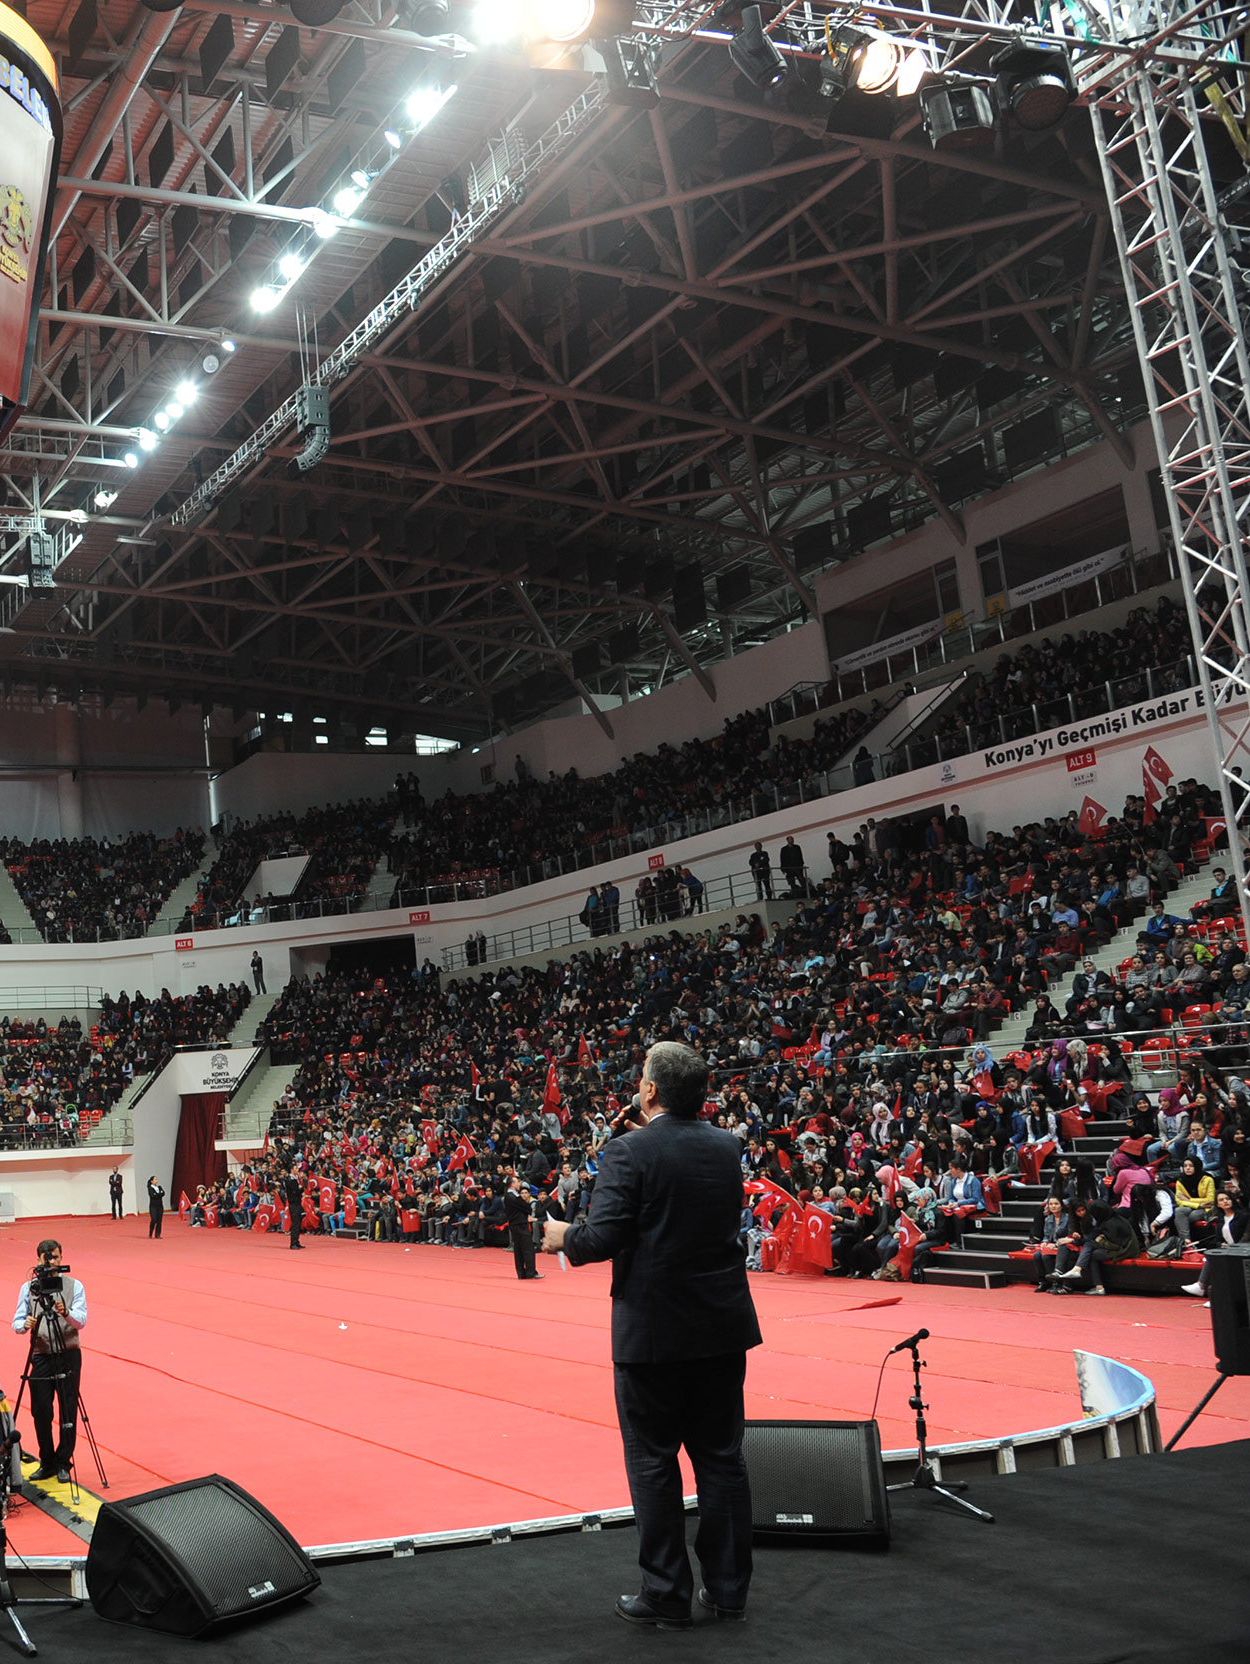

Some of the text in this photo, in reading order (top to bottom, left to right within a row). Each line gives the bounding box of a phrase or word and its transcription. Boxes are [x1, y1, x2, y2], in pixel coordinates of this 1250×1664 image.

[1057, 713, 1127, 747] Geçmişi
[1131, 697, 1189, 725] Kadar
[1070, 753, 1093, 768] ALT 9
